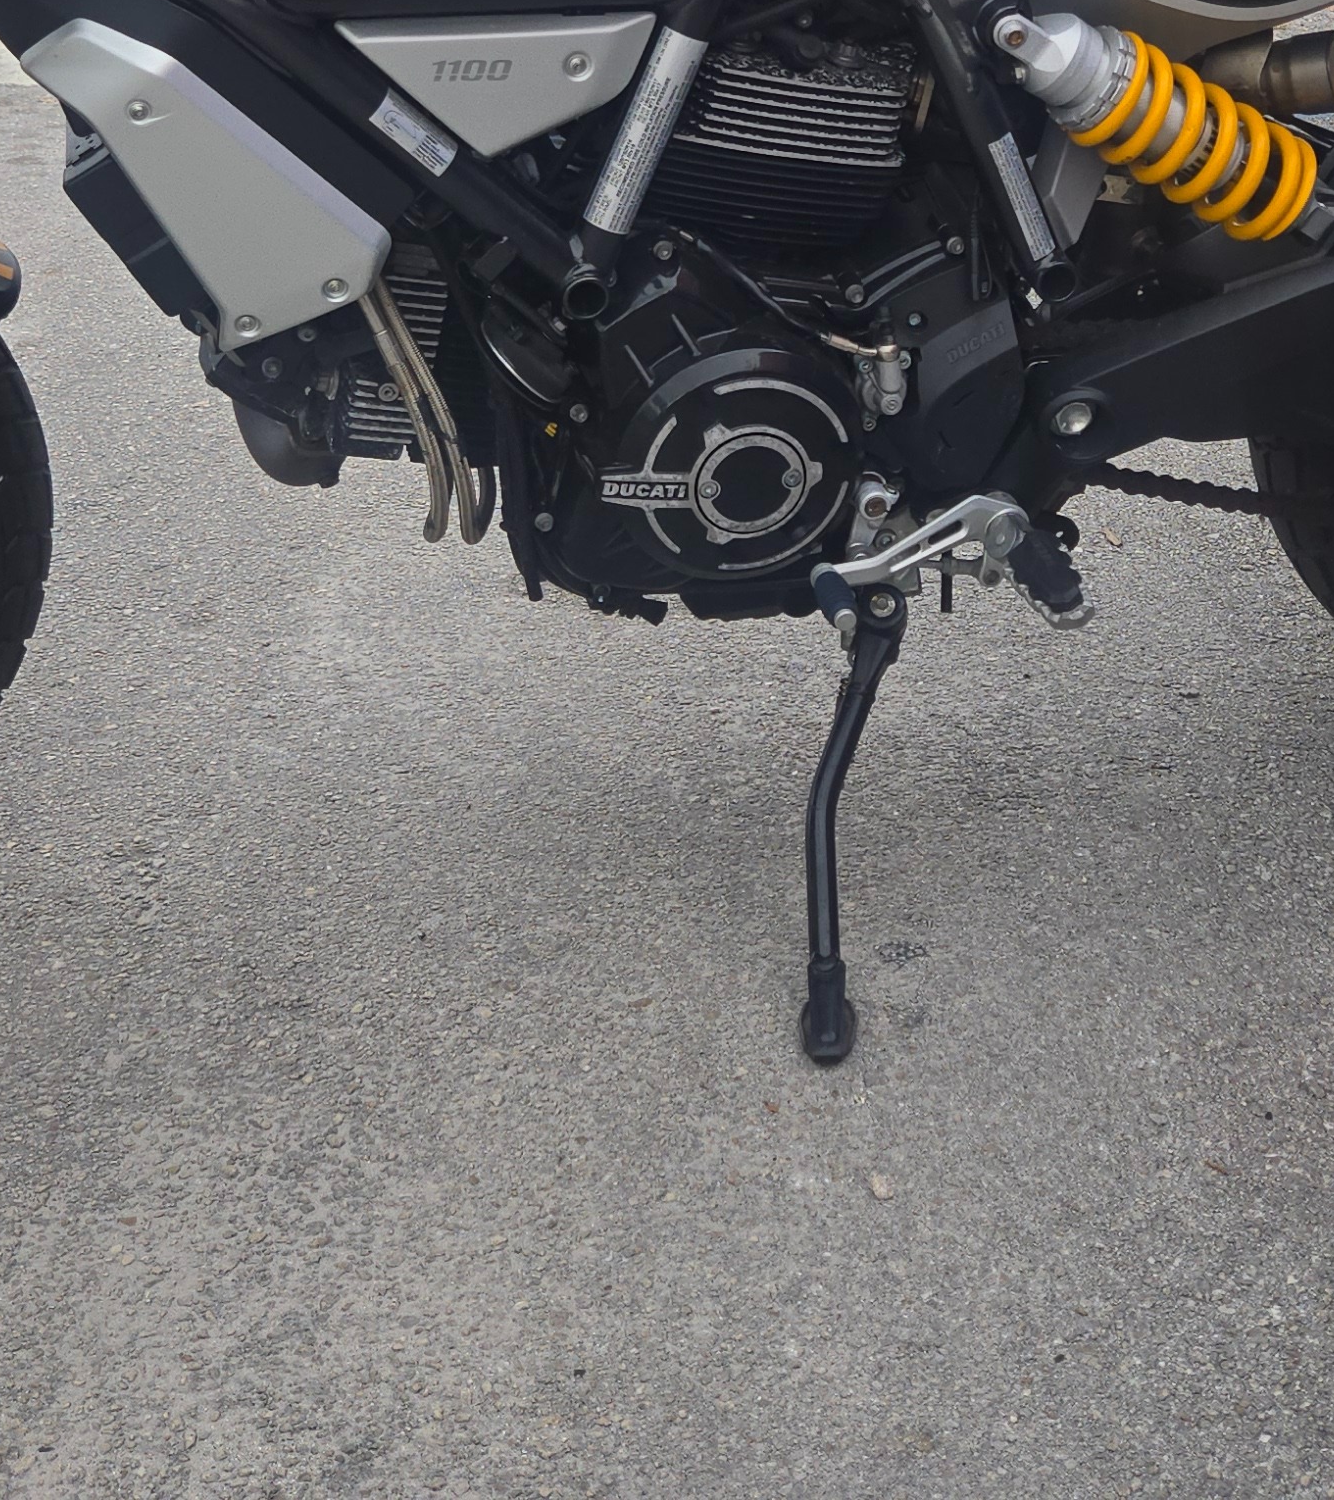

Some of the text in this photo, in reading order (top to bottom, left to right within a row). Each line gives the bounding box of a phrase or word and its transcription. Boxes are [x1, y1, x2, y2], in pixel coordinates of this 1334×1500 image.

[432, 59, 513, 82] 1100
[946, 320, 1007, 365] DUCATI
[601, 481, 687, 498] DUCATI
